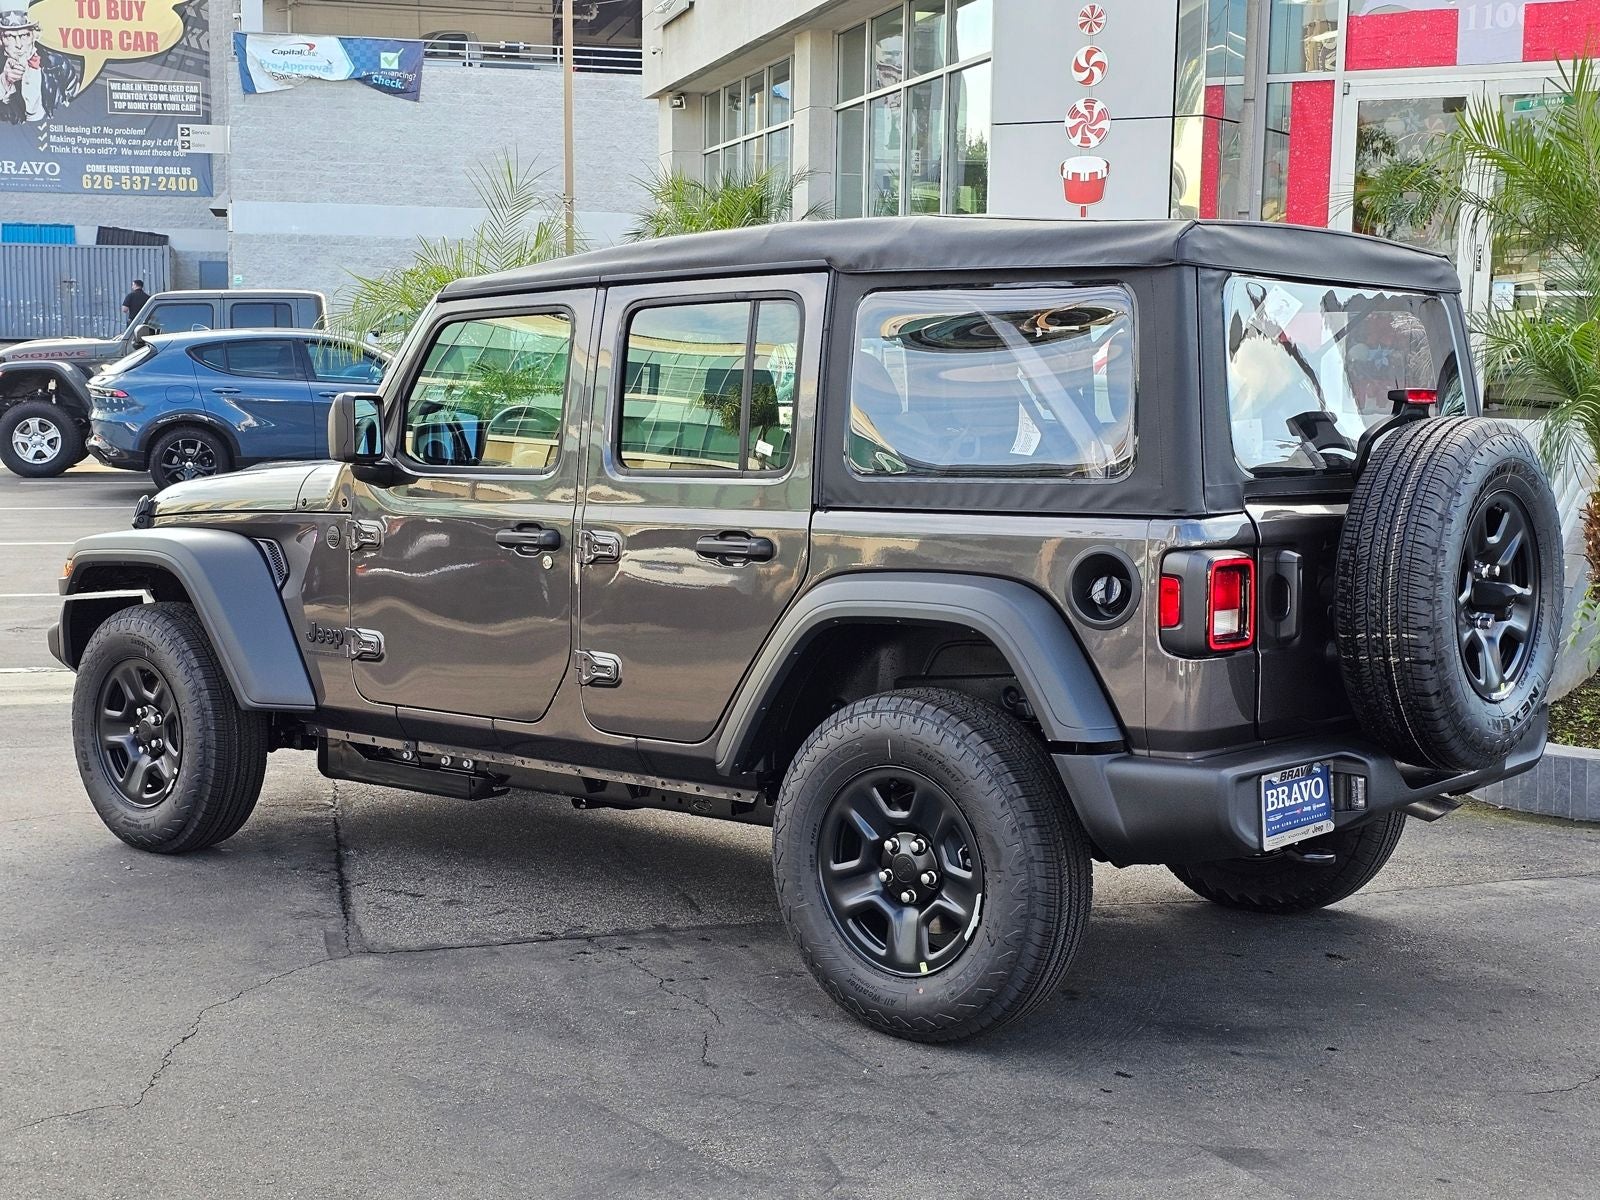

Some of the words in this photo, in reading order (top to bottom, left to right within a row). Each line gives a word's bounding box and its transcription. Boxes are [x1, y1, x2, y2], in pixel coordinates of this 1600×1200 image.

[75, 0, 100, 19] TO
[106, 0, 146, 21] BUY
[58, 27, 113, 50] YOUR
[118, 30, 159, 52] CAR
[110, 82, 120, 90] WE
[121, 83, 134, 91] ARE
[135, 83, 142, 91] IN
[142, 84, 159, 92] NEED
[159, 84, 167, 92] OF
[185, 85, 198, 93] CAR
[371, 74, 405, 90] Check.
[149, 93, 158, 101] SO
[169, 94, 184, 102] WILL
[114, 101, 126, 109] TOP
[127, 102, 149, 110] MONEY
[150, 102, 162, 110] FOR
[163, 103, 180, 111] YOUR
[181, 104, 196, 112] CAR!
[49, 124, 64, 132] Still
[65, 125, 91, 135] leasing
[92, 126, 101, 134] it?
[102, 126, 113, 134] No
[114, 127, 147, 136] problem!
[49, 134, 76, 145] Making
[77, 135, 114, 146] Payments,
[115, 137, 126, 145] We
[142, 139, 155, 148] pay
[156, 138, 162, 146] it
[162, 138, 174, 147] off
[50, 145, 70, 153] Think
[71, 146, 83, 154] it's
[97, 147, 118, 155] old??
[121, 147, 133, 155] We
[0, 160, 61, 176] RAVO
[86, 164, 107, 173] COME
[107, 165, 130, 174] INSIDE
[131, 166, 153, 174] TODAY
[153, 166, 164, 174] OR
[164, 166, 181, 175] CALL
[181, 167, 192, 175] US
[82, 174, 198, 192] 626-537-2400
[12, 351, 88, 360] MOJAVE
[305, 621, 344, 650] Jeep
[1266, 777, 1324, 812] BRAVO
[1311, 823, 1324, 834] Jeep
